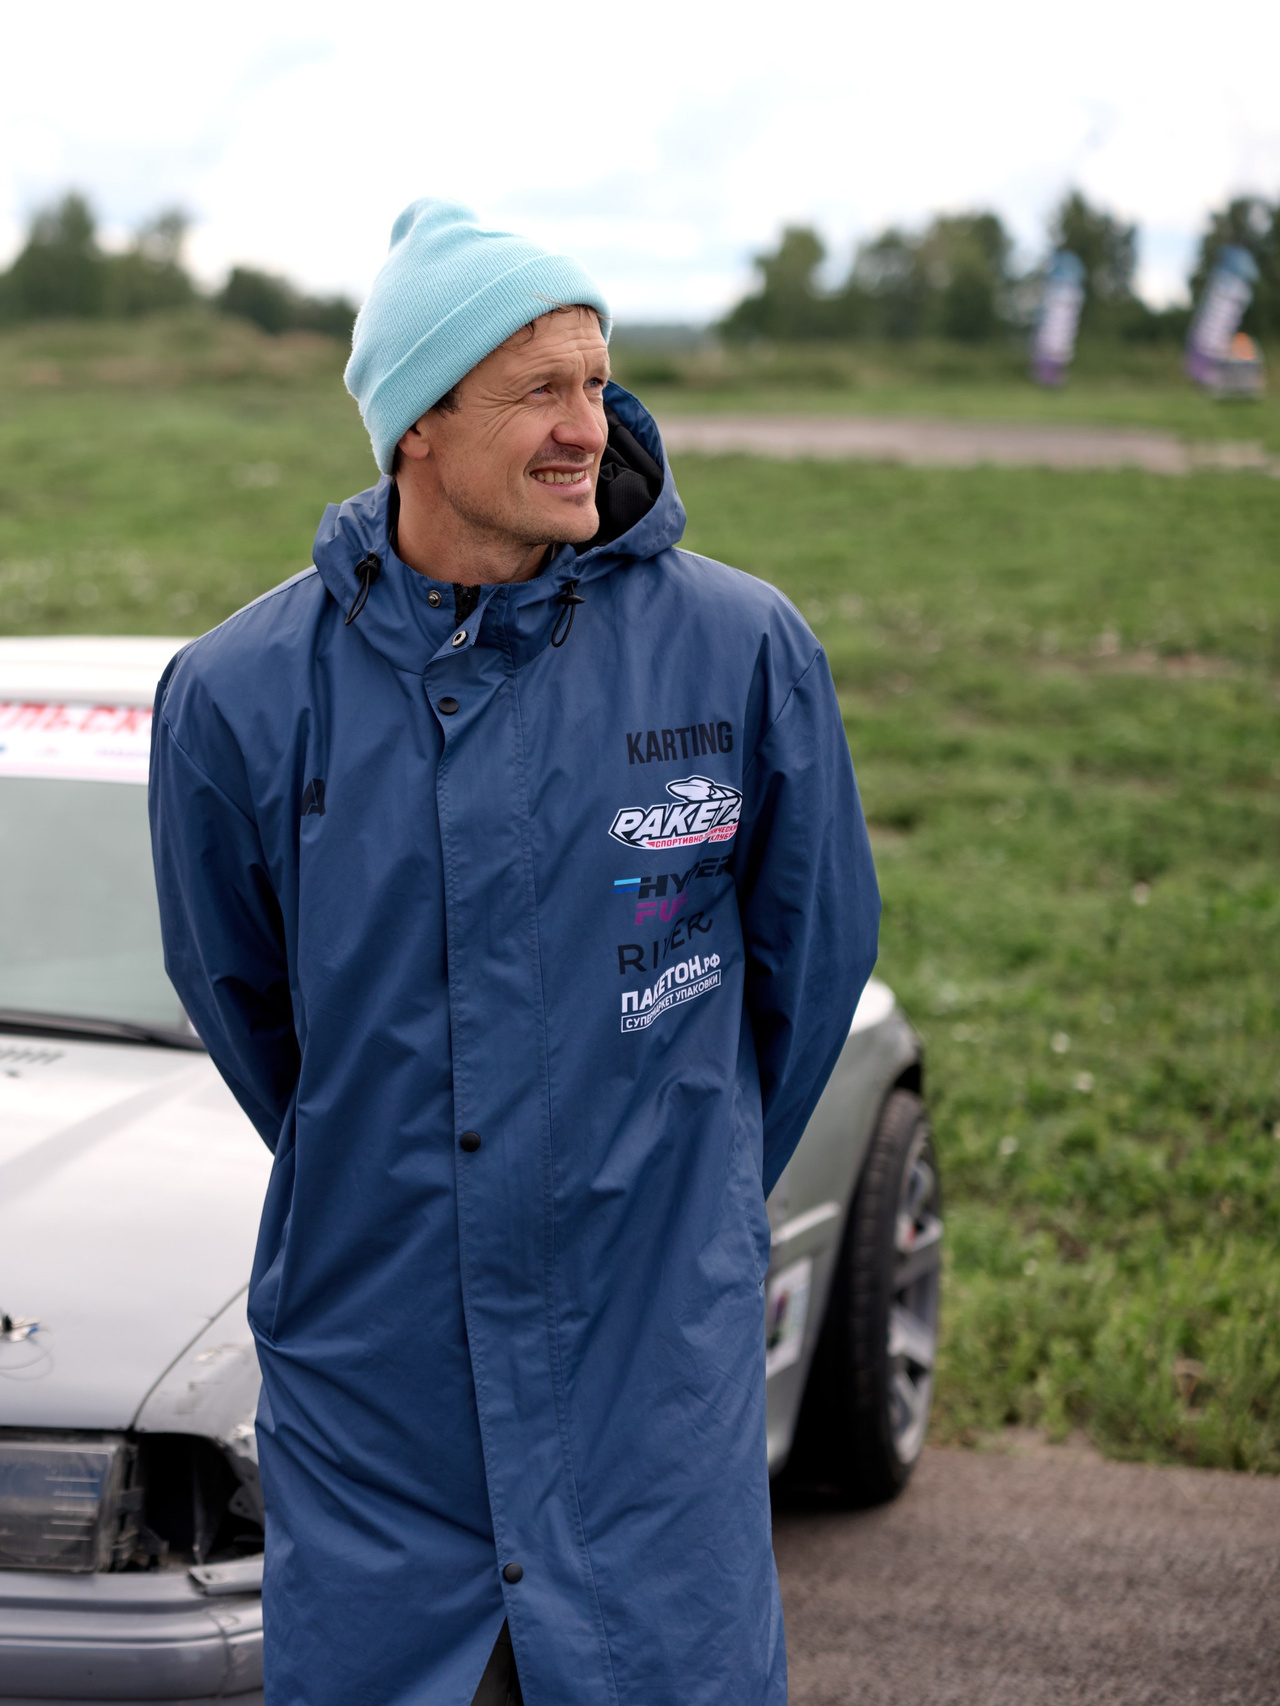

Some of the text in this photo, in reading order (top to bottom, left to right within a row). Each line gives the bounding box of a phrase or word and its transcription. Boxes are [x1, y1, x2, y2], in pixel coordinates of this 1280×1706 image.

[626, 721, 734, 765] KARTING
[613, 799, 741, 841] РАКЕТА
[617, 911, 713, 975] RIVER
[675, 974, 718, 1001] УПАКОВКИ
